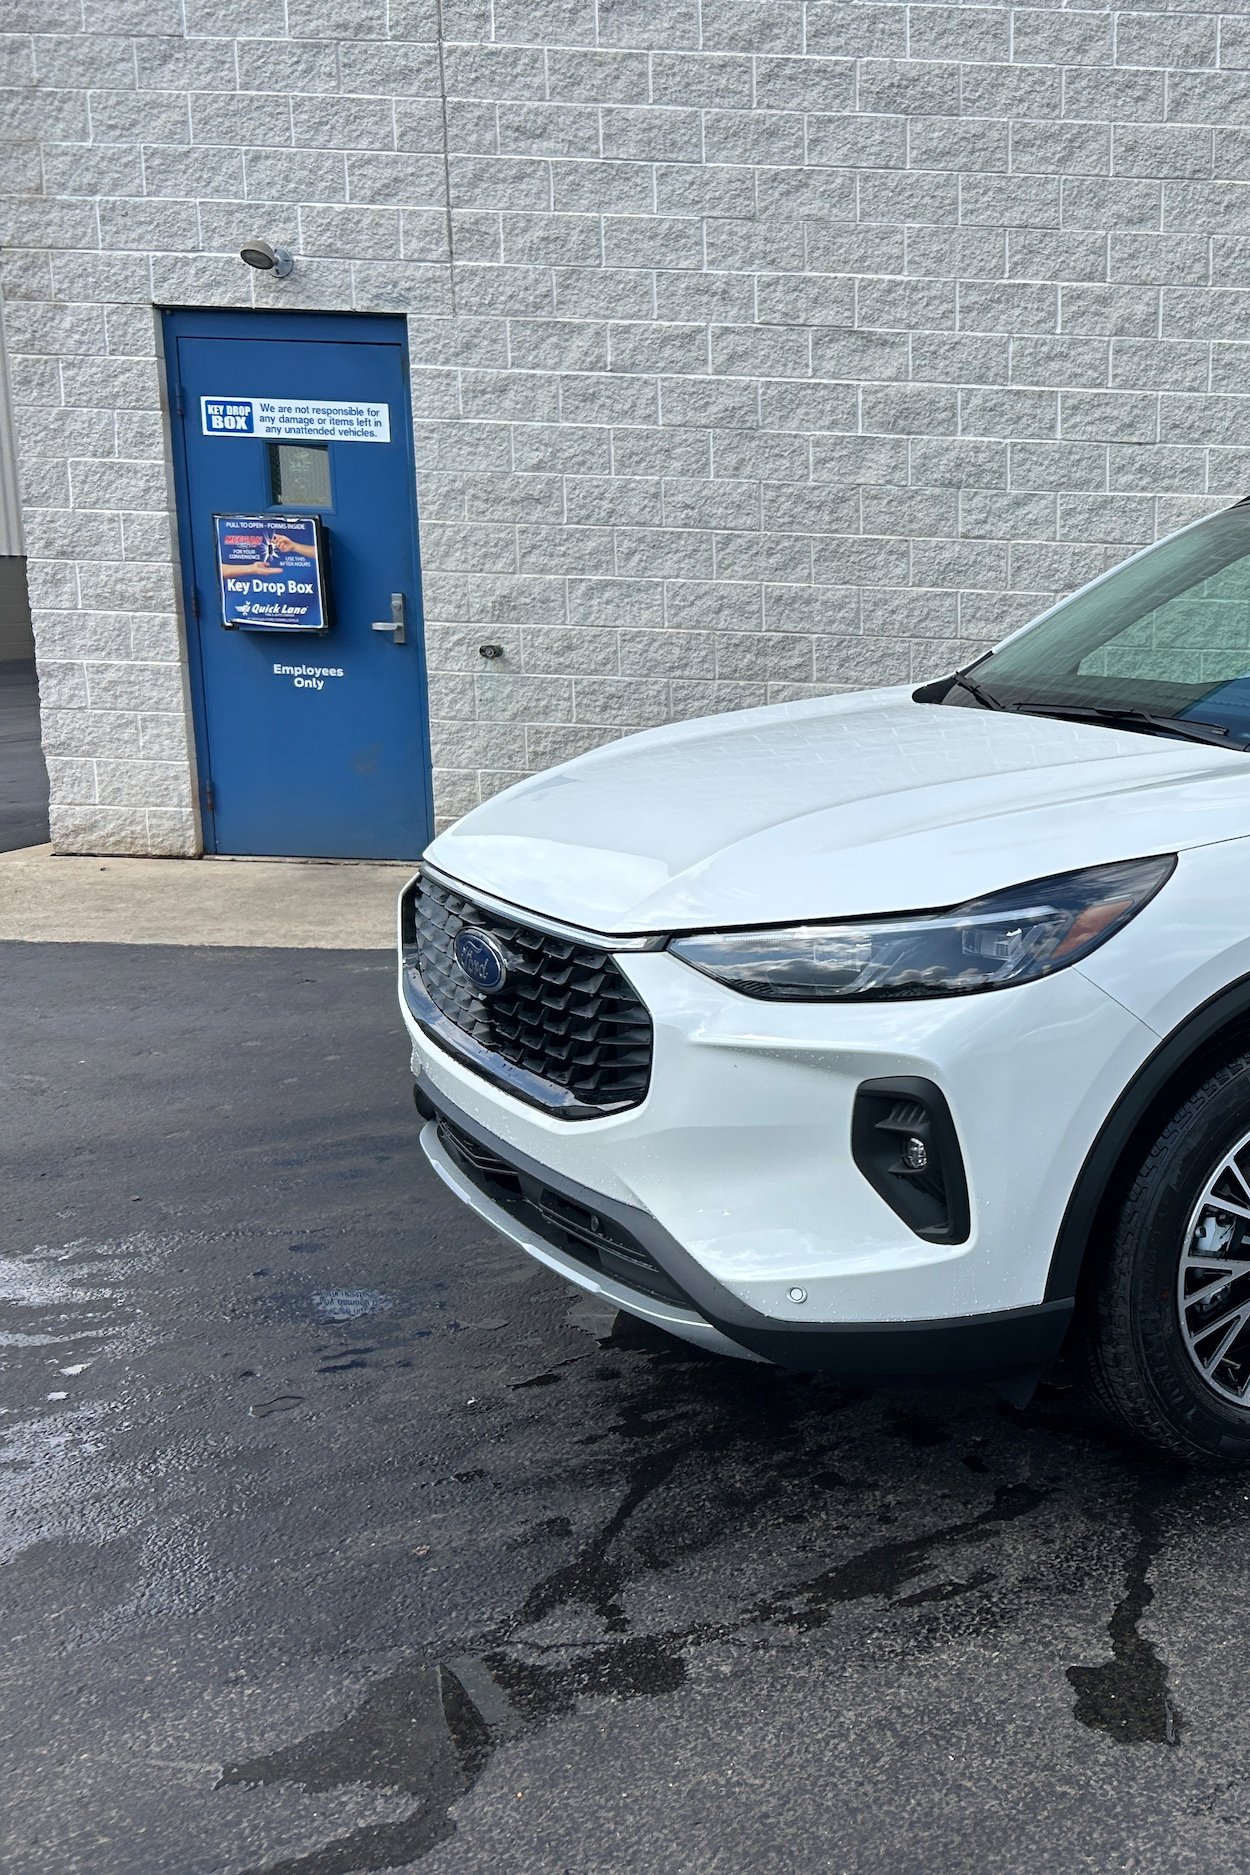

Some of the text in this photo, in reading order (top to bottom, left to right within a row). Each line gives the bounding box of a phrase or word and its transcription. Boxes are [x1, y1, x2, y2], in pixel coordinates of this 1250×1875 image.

[207, 404, 251, 418] KEY DROP
[260, 403, 380, 418] We are not responsible for
[211, 416, 249, 430] BOX
[259, 414, 383, 427] any damage or items left in
[266, 425, 378, 437] any unattended vehicles.
[227, 578, 314, 596] Key Drop Box
[251, 603, 308, 615] Quick Lane
[273, 664, 344, 678] Employees
[293, 677, 325, 690] Only
[461, 940, 489, 980] Ford
